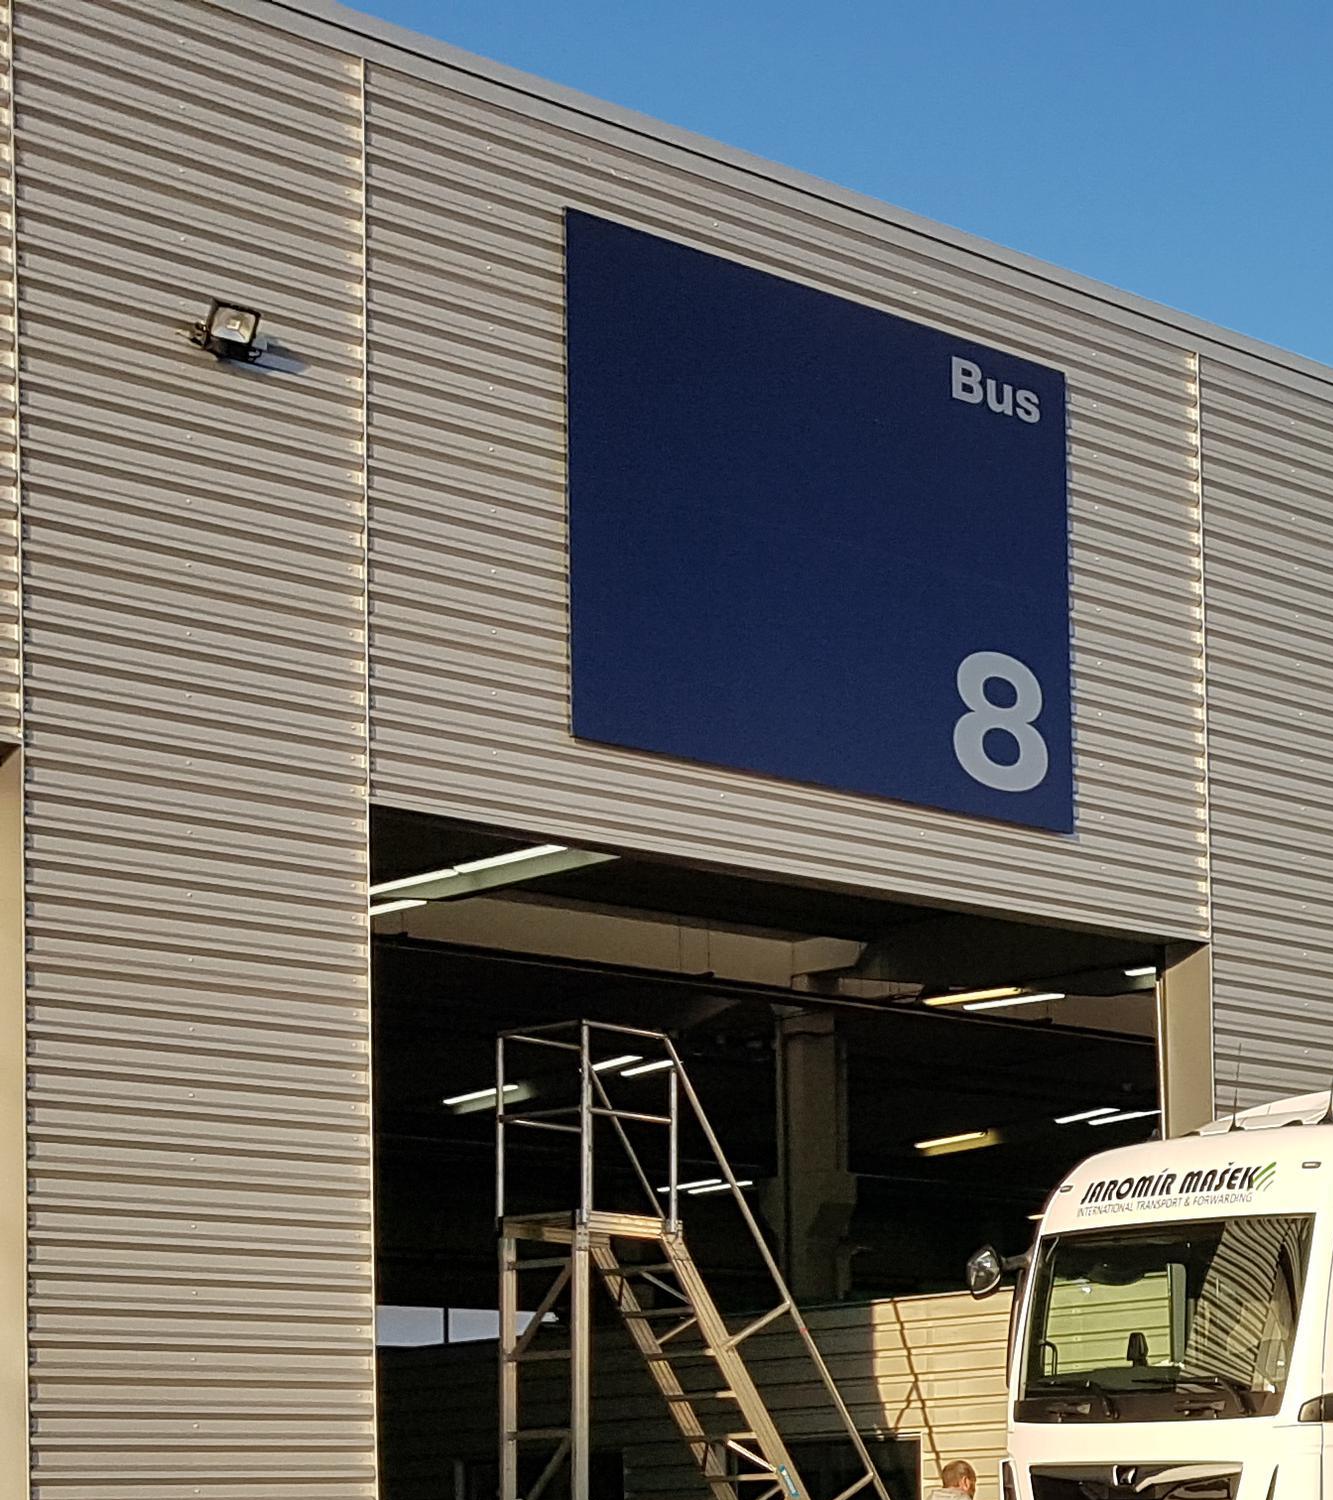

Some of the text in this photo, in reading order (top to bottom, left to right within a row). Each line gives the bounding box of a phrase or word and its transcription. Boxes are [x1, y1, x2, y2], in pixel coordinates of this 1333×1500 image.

[952, 356, 1040, 423] Bus
[953, 651, 1048, 792] 8
[1077, 1192, 1252, 1217] INTERNATIONAL TRANSPORT & FORWARDING
